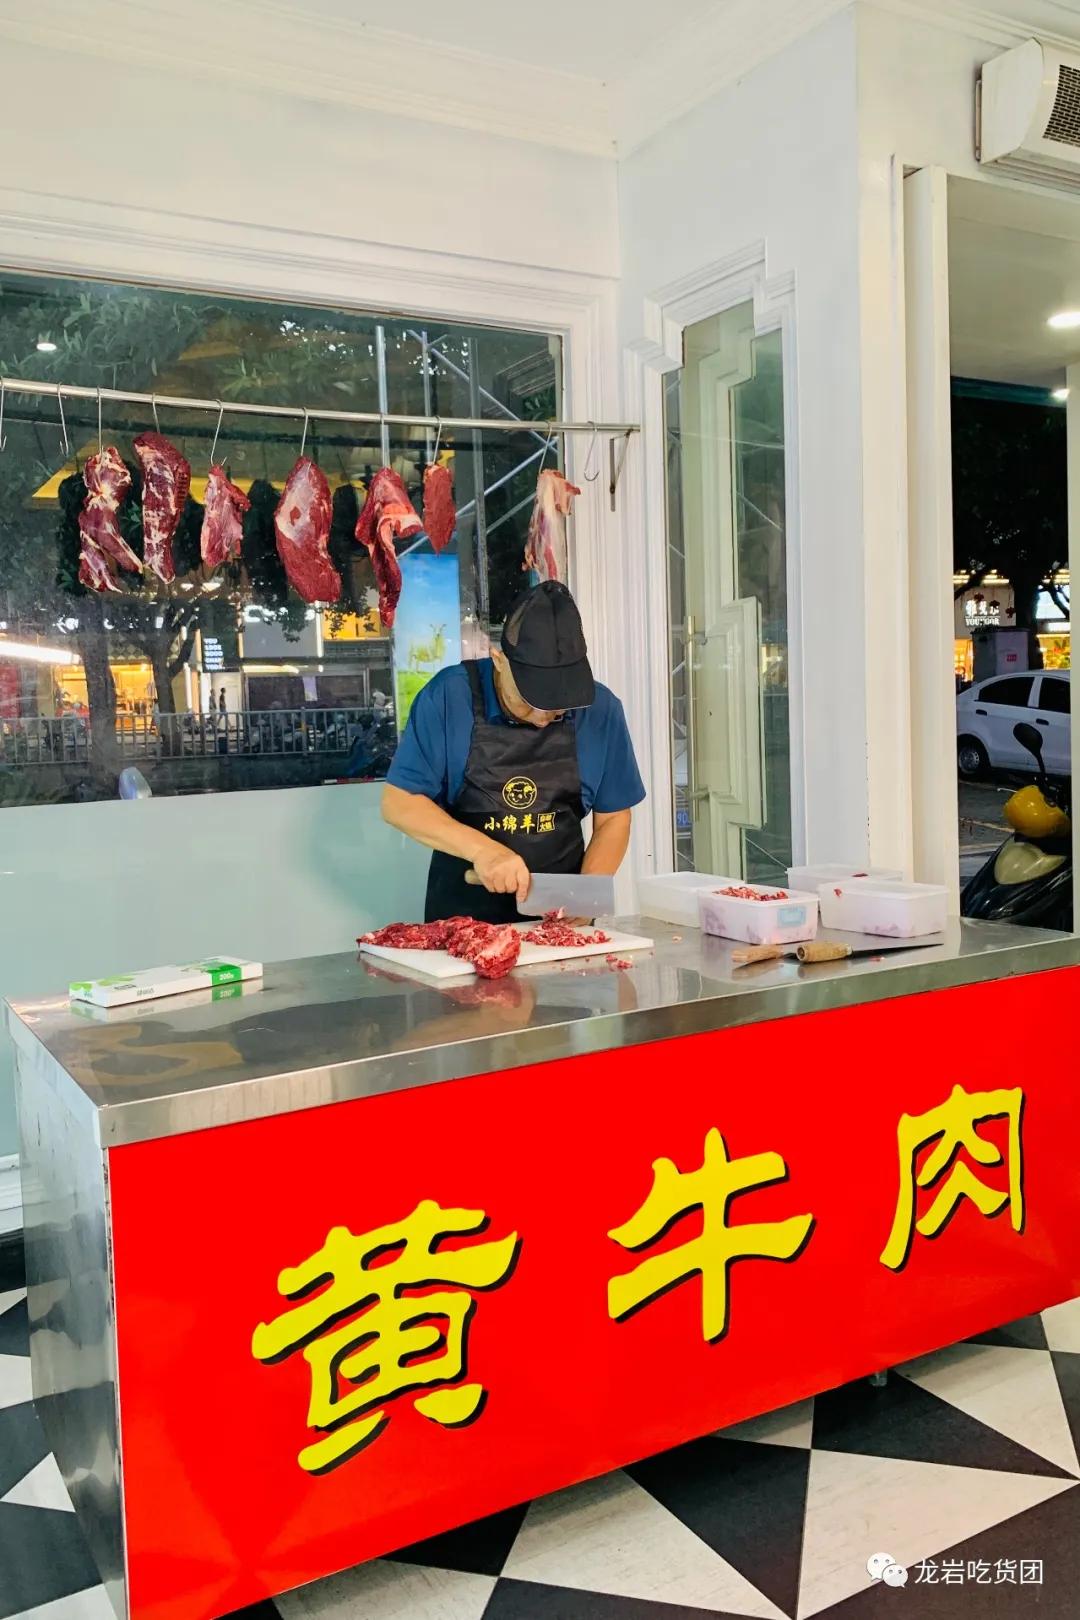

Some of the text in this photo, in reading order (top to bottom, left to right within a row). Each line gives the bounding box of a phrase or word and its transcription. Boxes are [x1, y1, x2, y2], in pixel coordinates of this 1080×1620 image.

[484, 813, 535, 834] 小绵羊
[252, 1084, 1023, 1472] 黄牛肉
